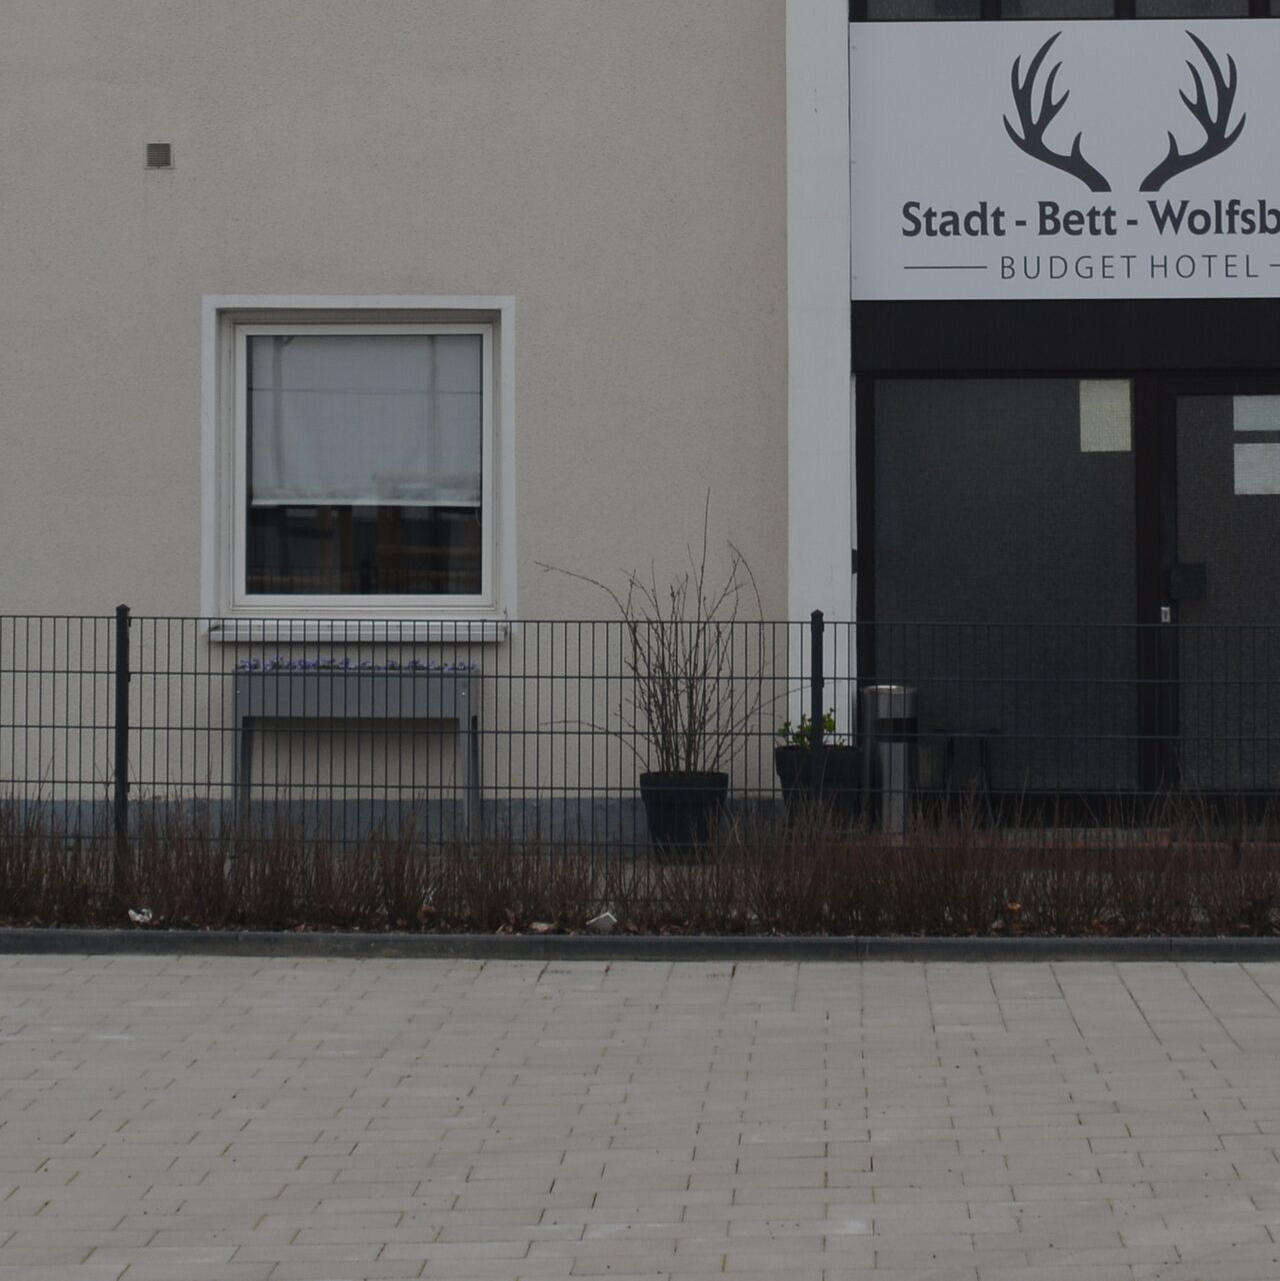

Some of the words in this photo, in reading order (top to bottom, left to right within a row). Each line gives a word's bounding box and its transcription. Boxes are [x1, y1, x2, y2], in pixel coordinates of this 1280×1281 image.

[902, 200, 1007, 237] Stadt
[1037, 200, 1118, 236] Bett
[1000, 254, 1137, 281] BUDGET
[1149, 253, 1260, 280] HOTEL
